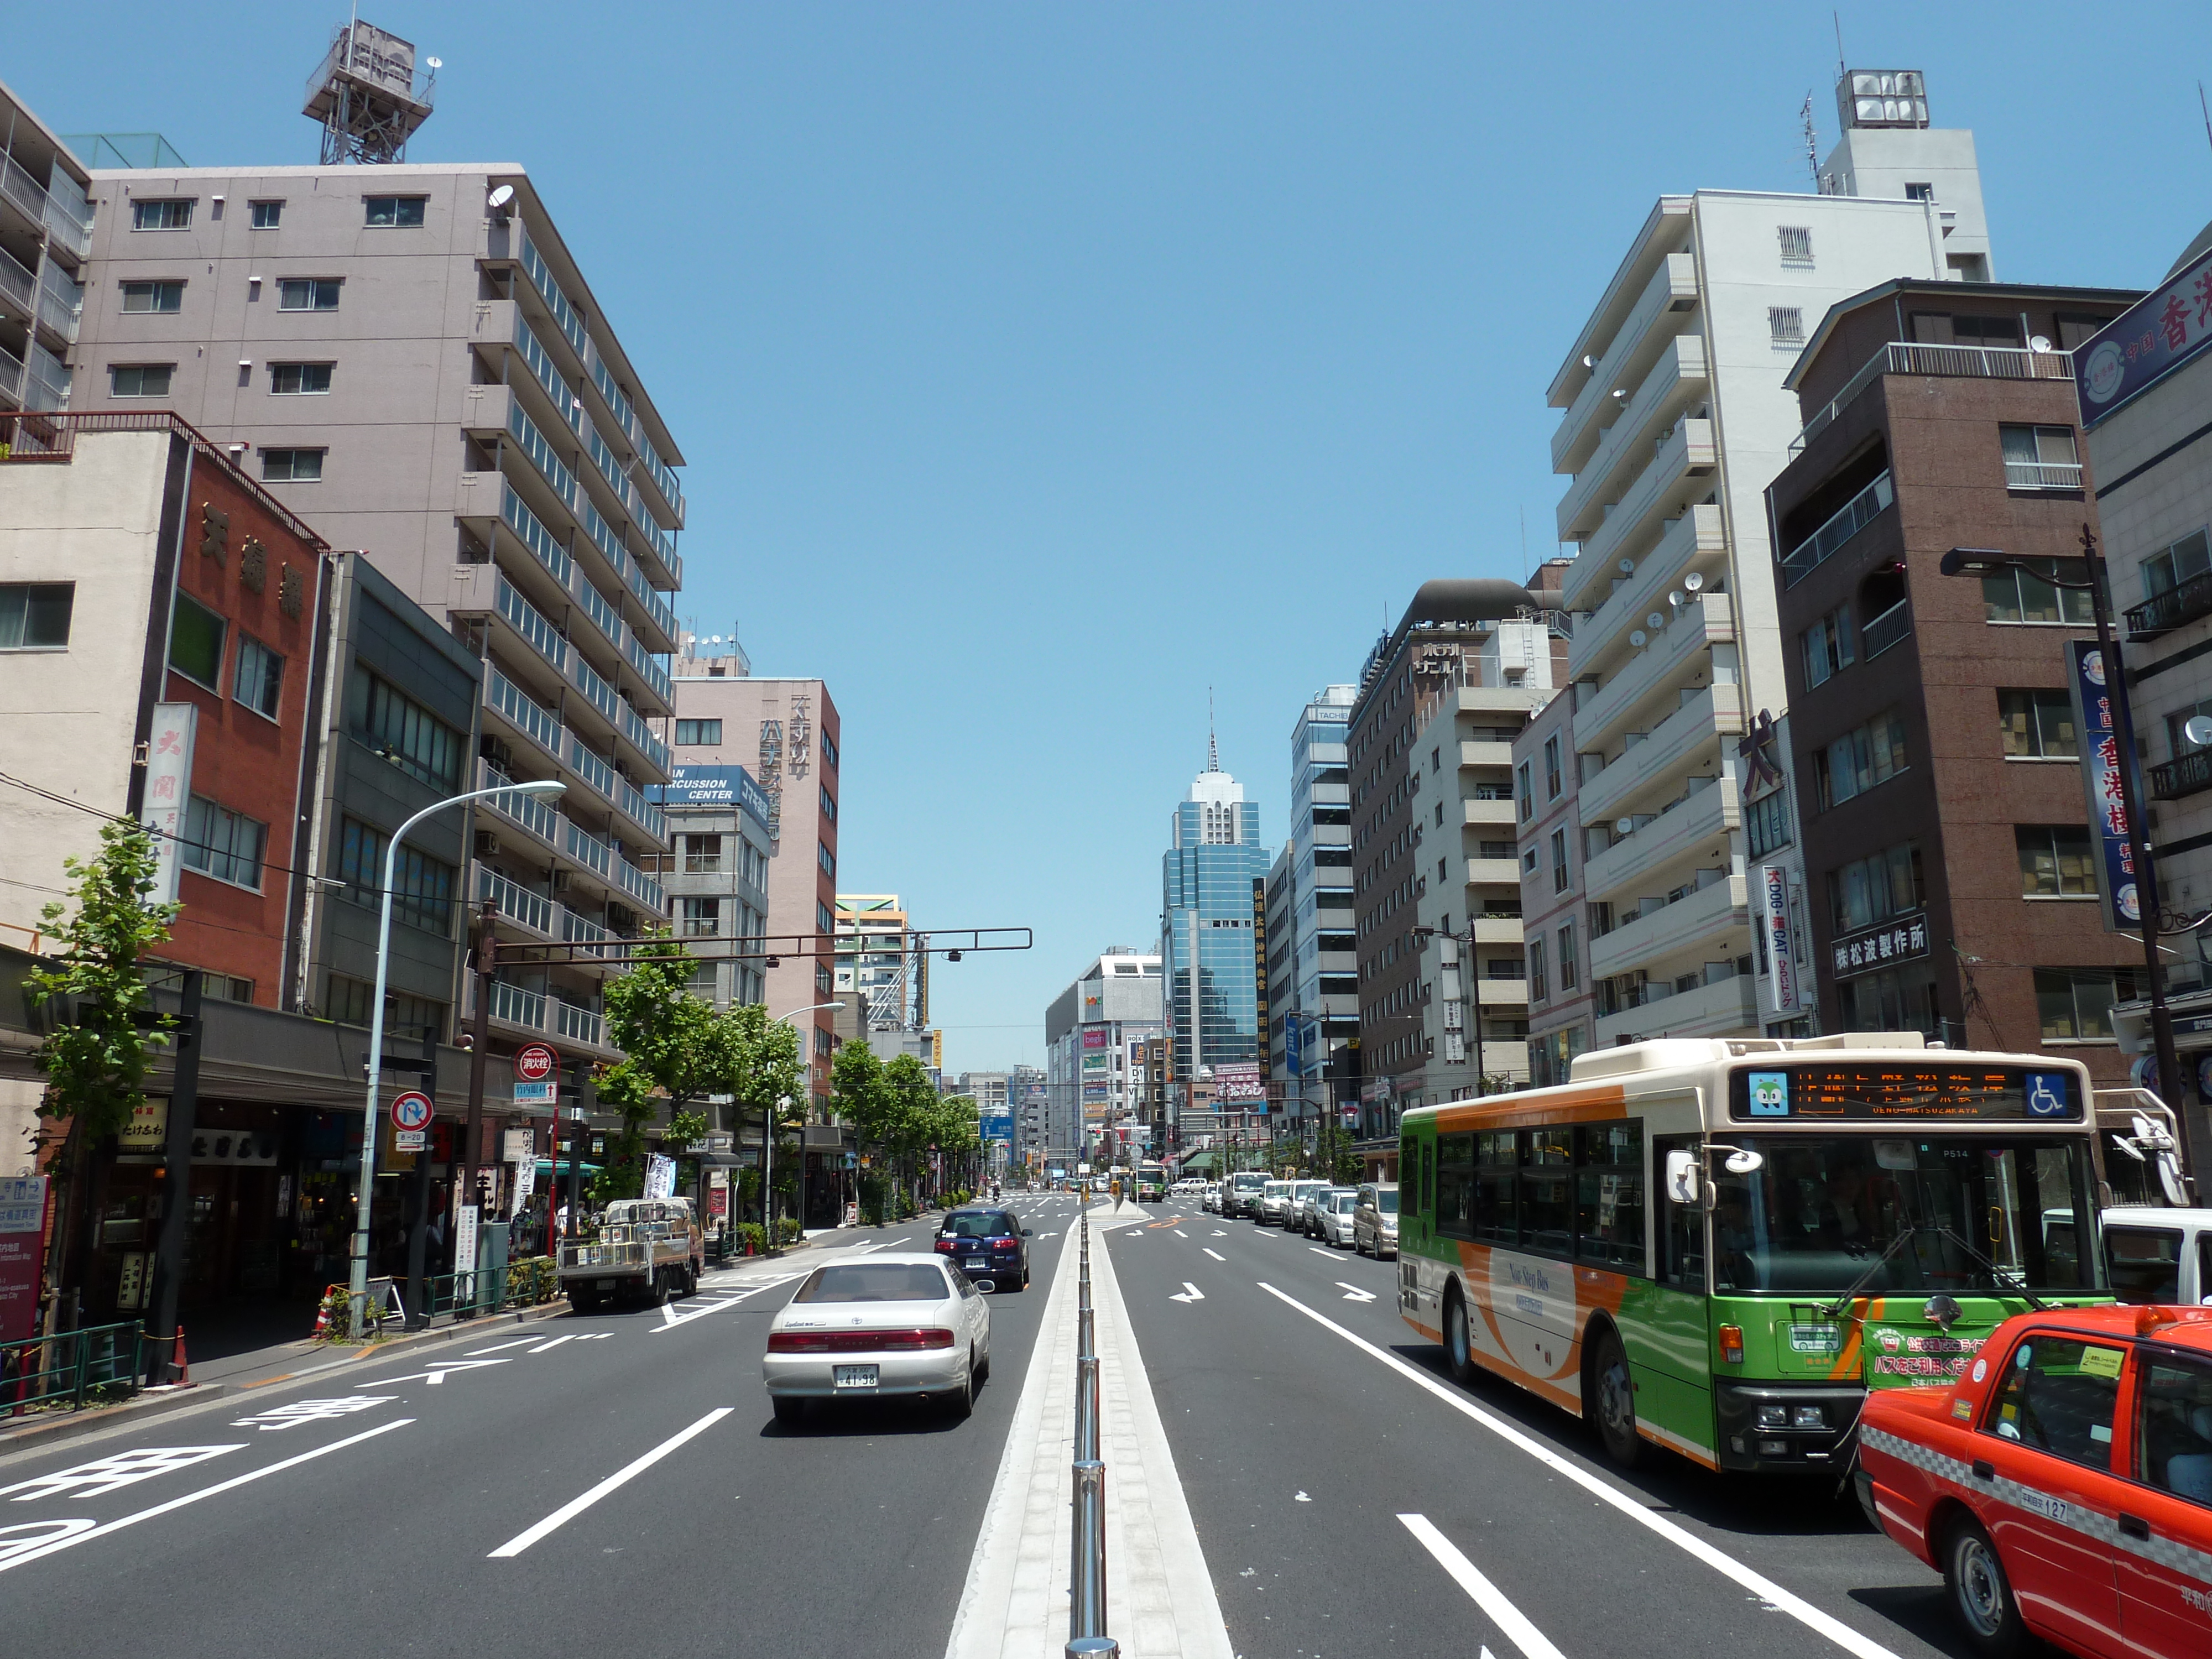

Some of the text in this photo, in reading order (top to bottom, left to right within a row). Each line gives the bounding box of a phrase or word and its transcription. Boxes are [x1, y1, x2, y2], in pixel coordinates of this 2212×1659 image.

[1422, 643, 1459, 656] ホテル
[790, 696, 811, 764] くすり
[688, 790, 733, 799] CENTER
[1085, 1034, 1104, 1044] begin
[1349, 1039, 1357, 1048] P
[523, 1057, 549, 1070] 消火栓
[1943, 1150, 1969, 1158] P514
[2045, 1499, 2067, 1519] 127
[2179, 1584, 2206, 1611] 平和
